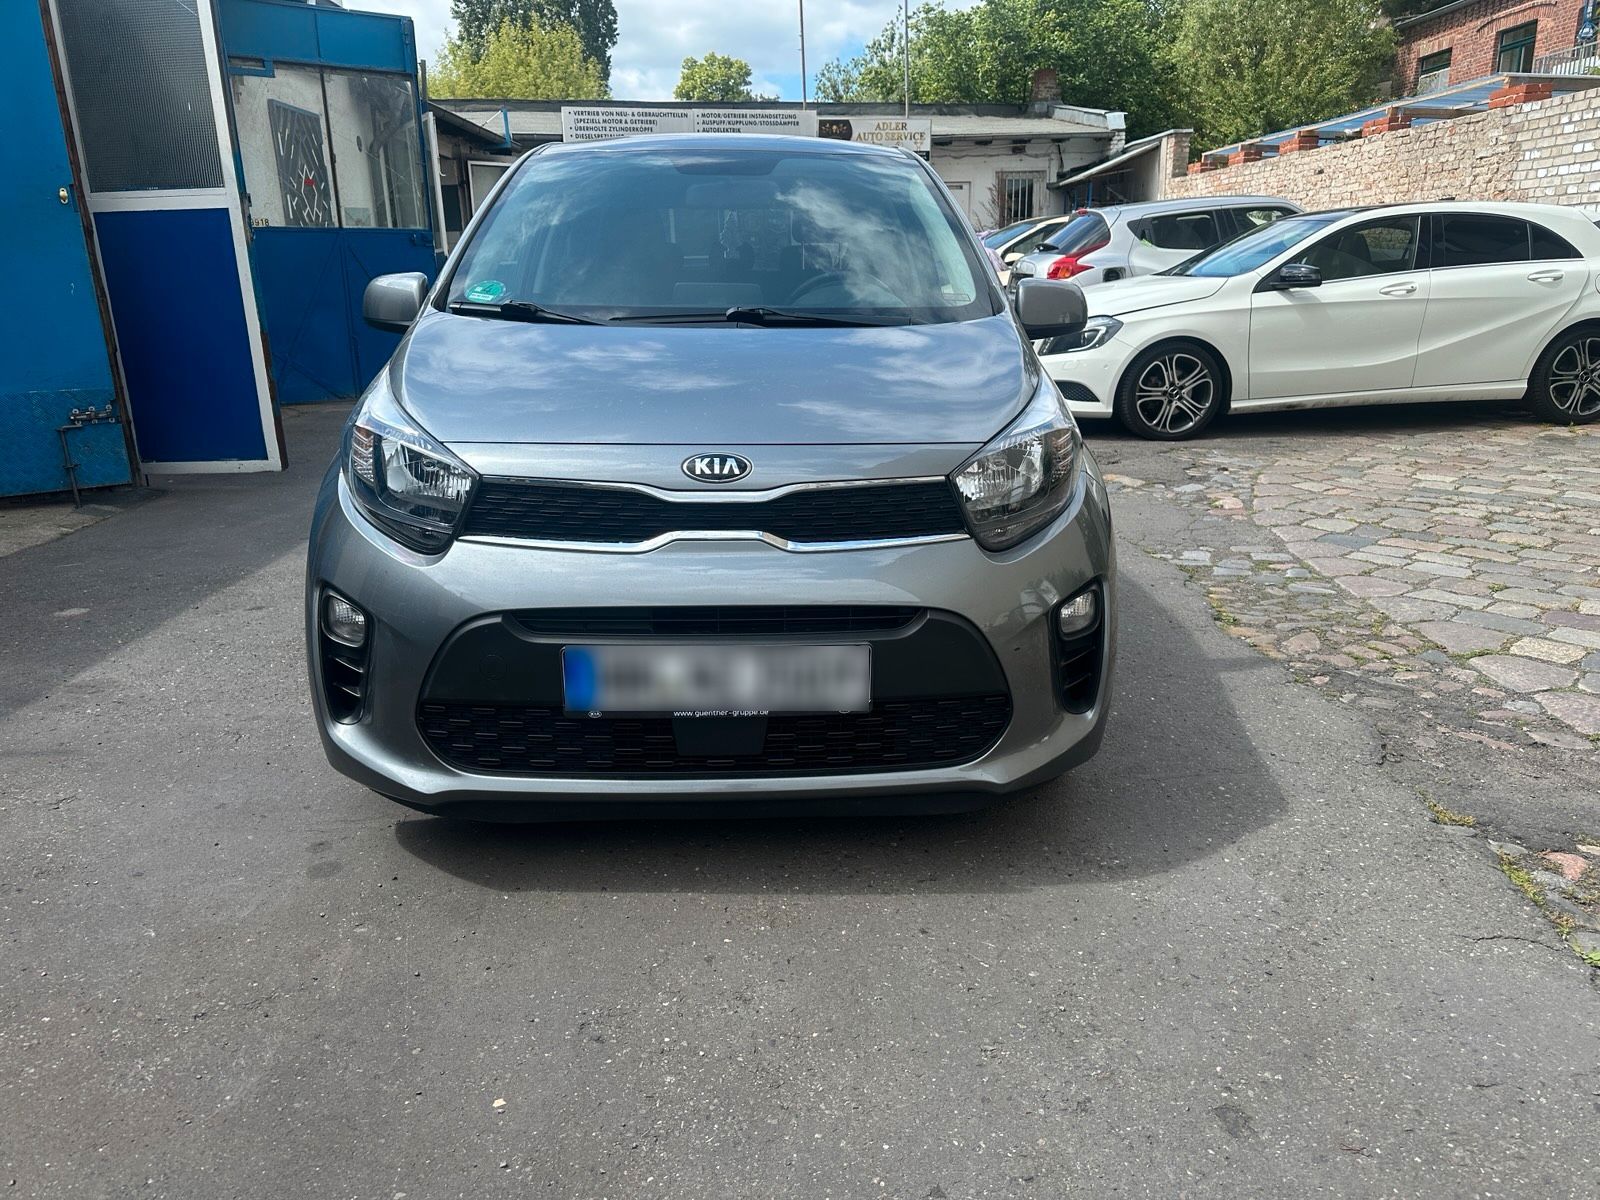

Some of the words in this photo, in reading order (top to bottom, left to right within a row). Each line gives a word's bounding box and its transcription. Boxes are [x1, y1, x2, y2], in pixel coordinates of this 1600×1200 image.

[630, 118, 658, 126] GETRIEBE)
[874, 122, 908, 131] ADLER
[608, 125, 653, 133] ZYLINDERKÖPFE
[855, 132, 884, 142] AUTO
[884, 132, 926, 142] SERVICE
[694, 457, 741, 475] KIA
